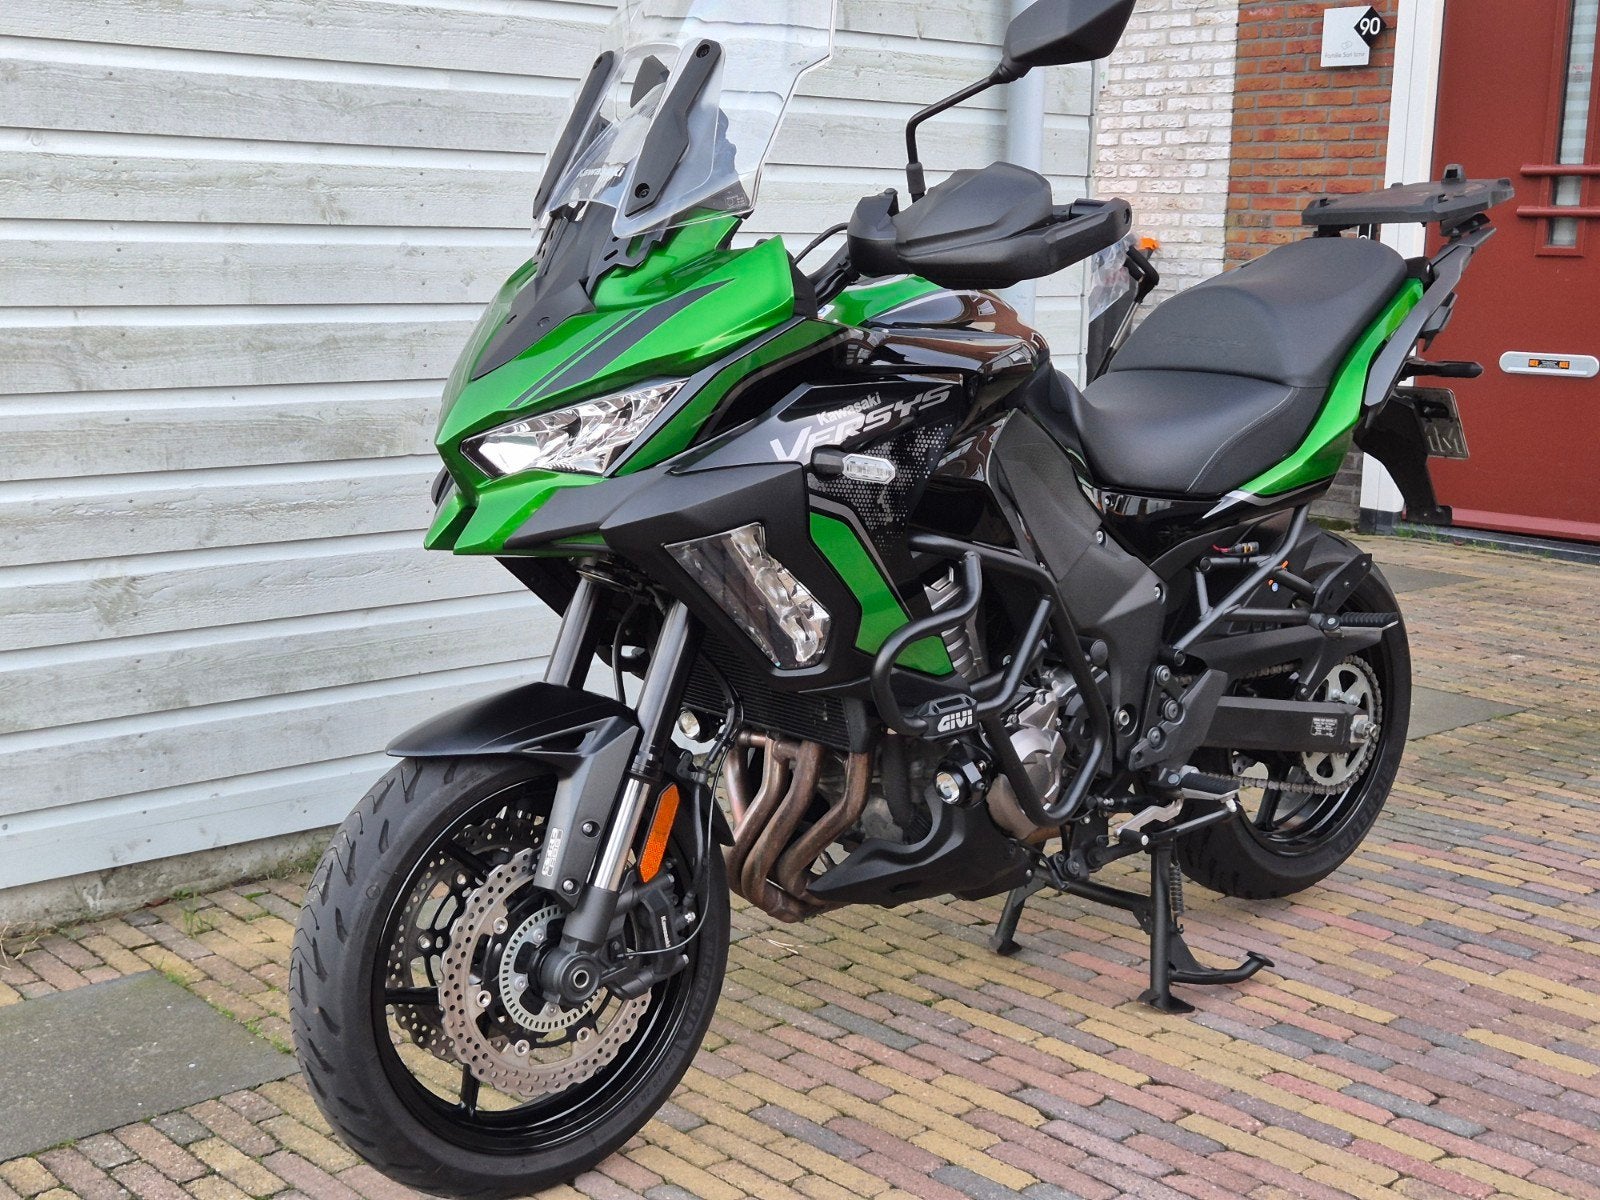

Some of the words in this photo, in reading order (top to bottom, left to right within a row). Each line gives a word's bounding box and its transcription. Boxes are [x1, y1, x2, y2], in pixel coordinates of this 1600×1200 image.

[1360, 17, 1380, 35] 90
[769, 384, 954, 461] VERSYS
[816, 391, 882, 426] Kawasaki
[937, 709, 973, 732] GIVI
